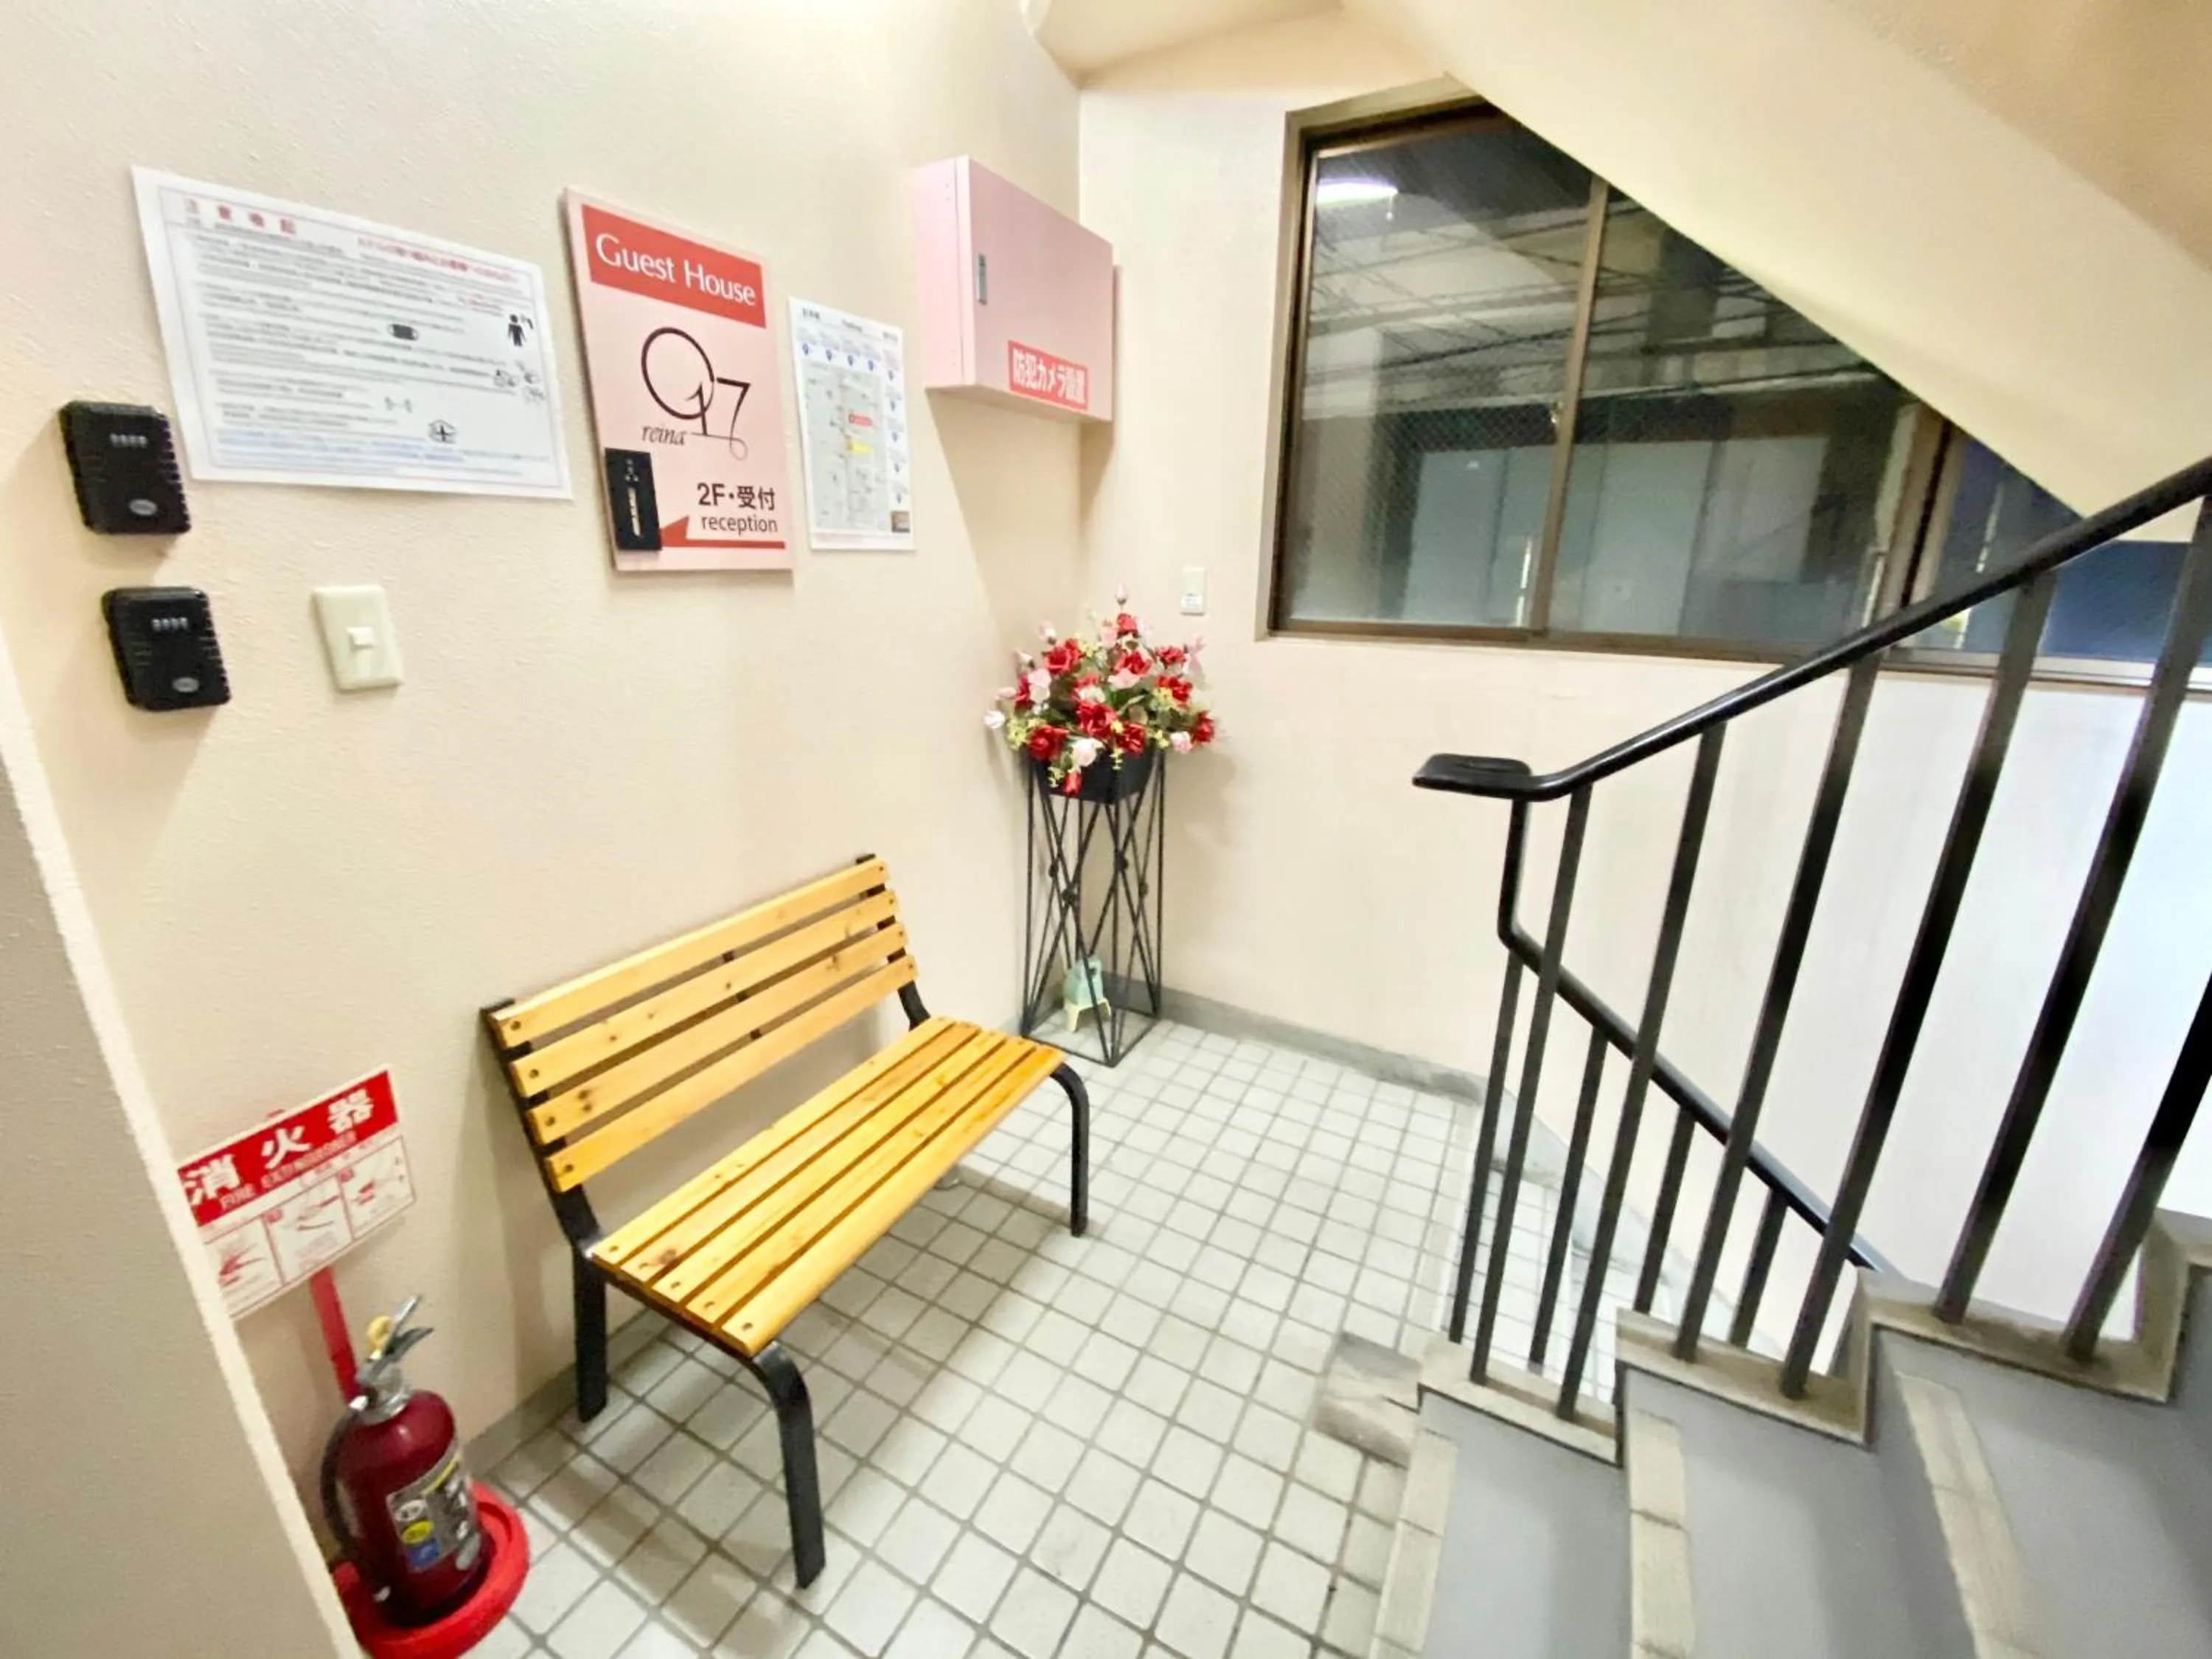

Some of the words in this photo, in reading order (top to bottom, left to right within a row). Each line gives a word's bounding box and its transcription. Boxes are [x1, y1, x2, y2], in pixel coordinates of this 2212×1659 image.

[596, 233, 675, 284] Guest
[683, 260, 756, 306] House
[641, 425, 687, 445] reina
[701, 515, 778, 535] reception
[184, 1088, 375, 1206] 消火器
